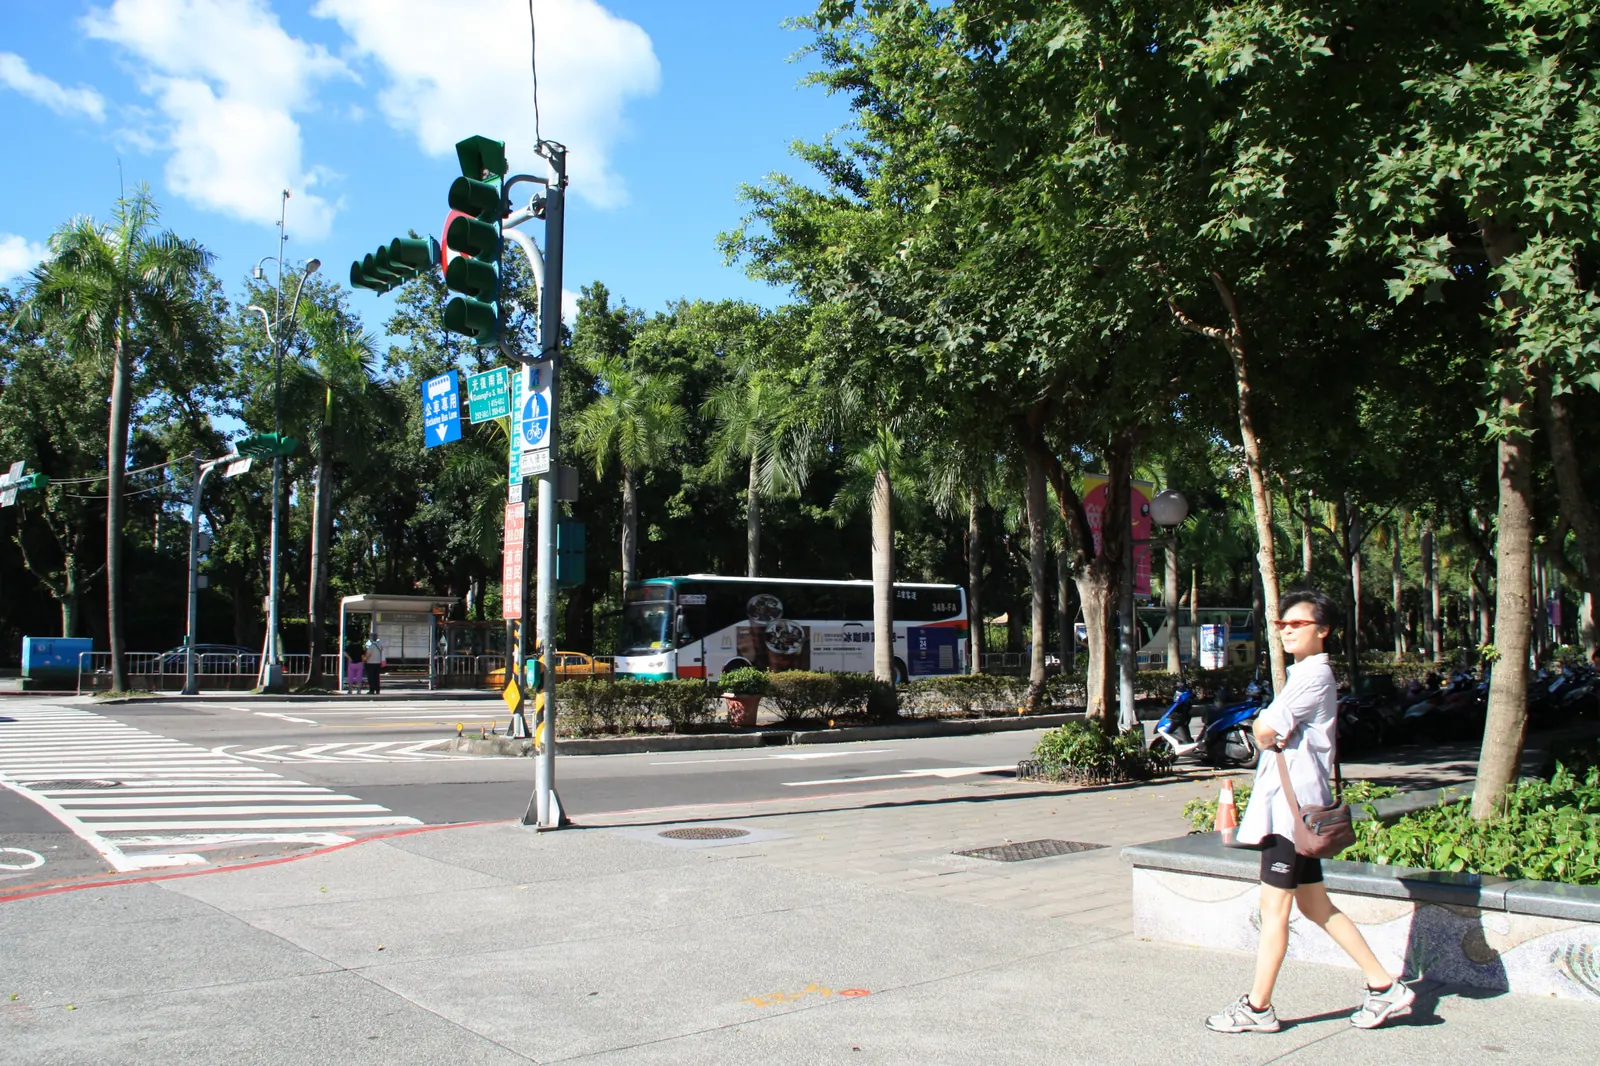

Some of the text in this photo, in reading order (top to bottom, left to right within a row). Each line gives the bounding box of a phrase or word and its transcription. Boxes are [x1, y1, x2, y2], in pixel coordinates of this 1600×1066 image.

[471, 372, 503, 391] 光復南路
[425, 393, 457, 417] 公車專用
[425, 411, 458, 427] Exclusive Bus Lane
